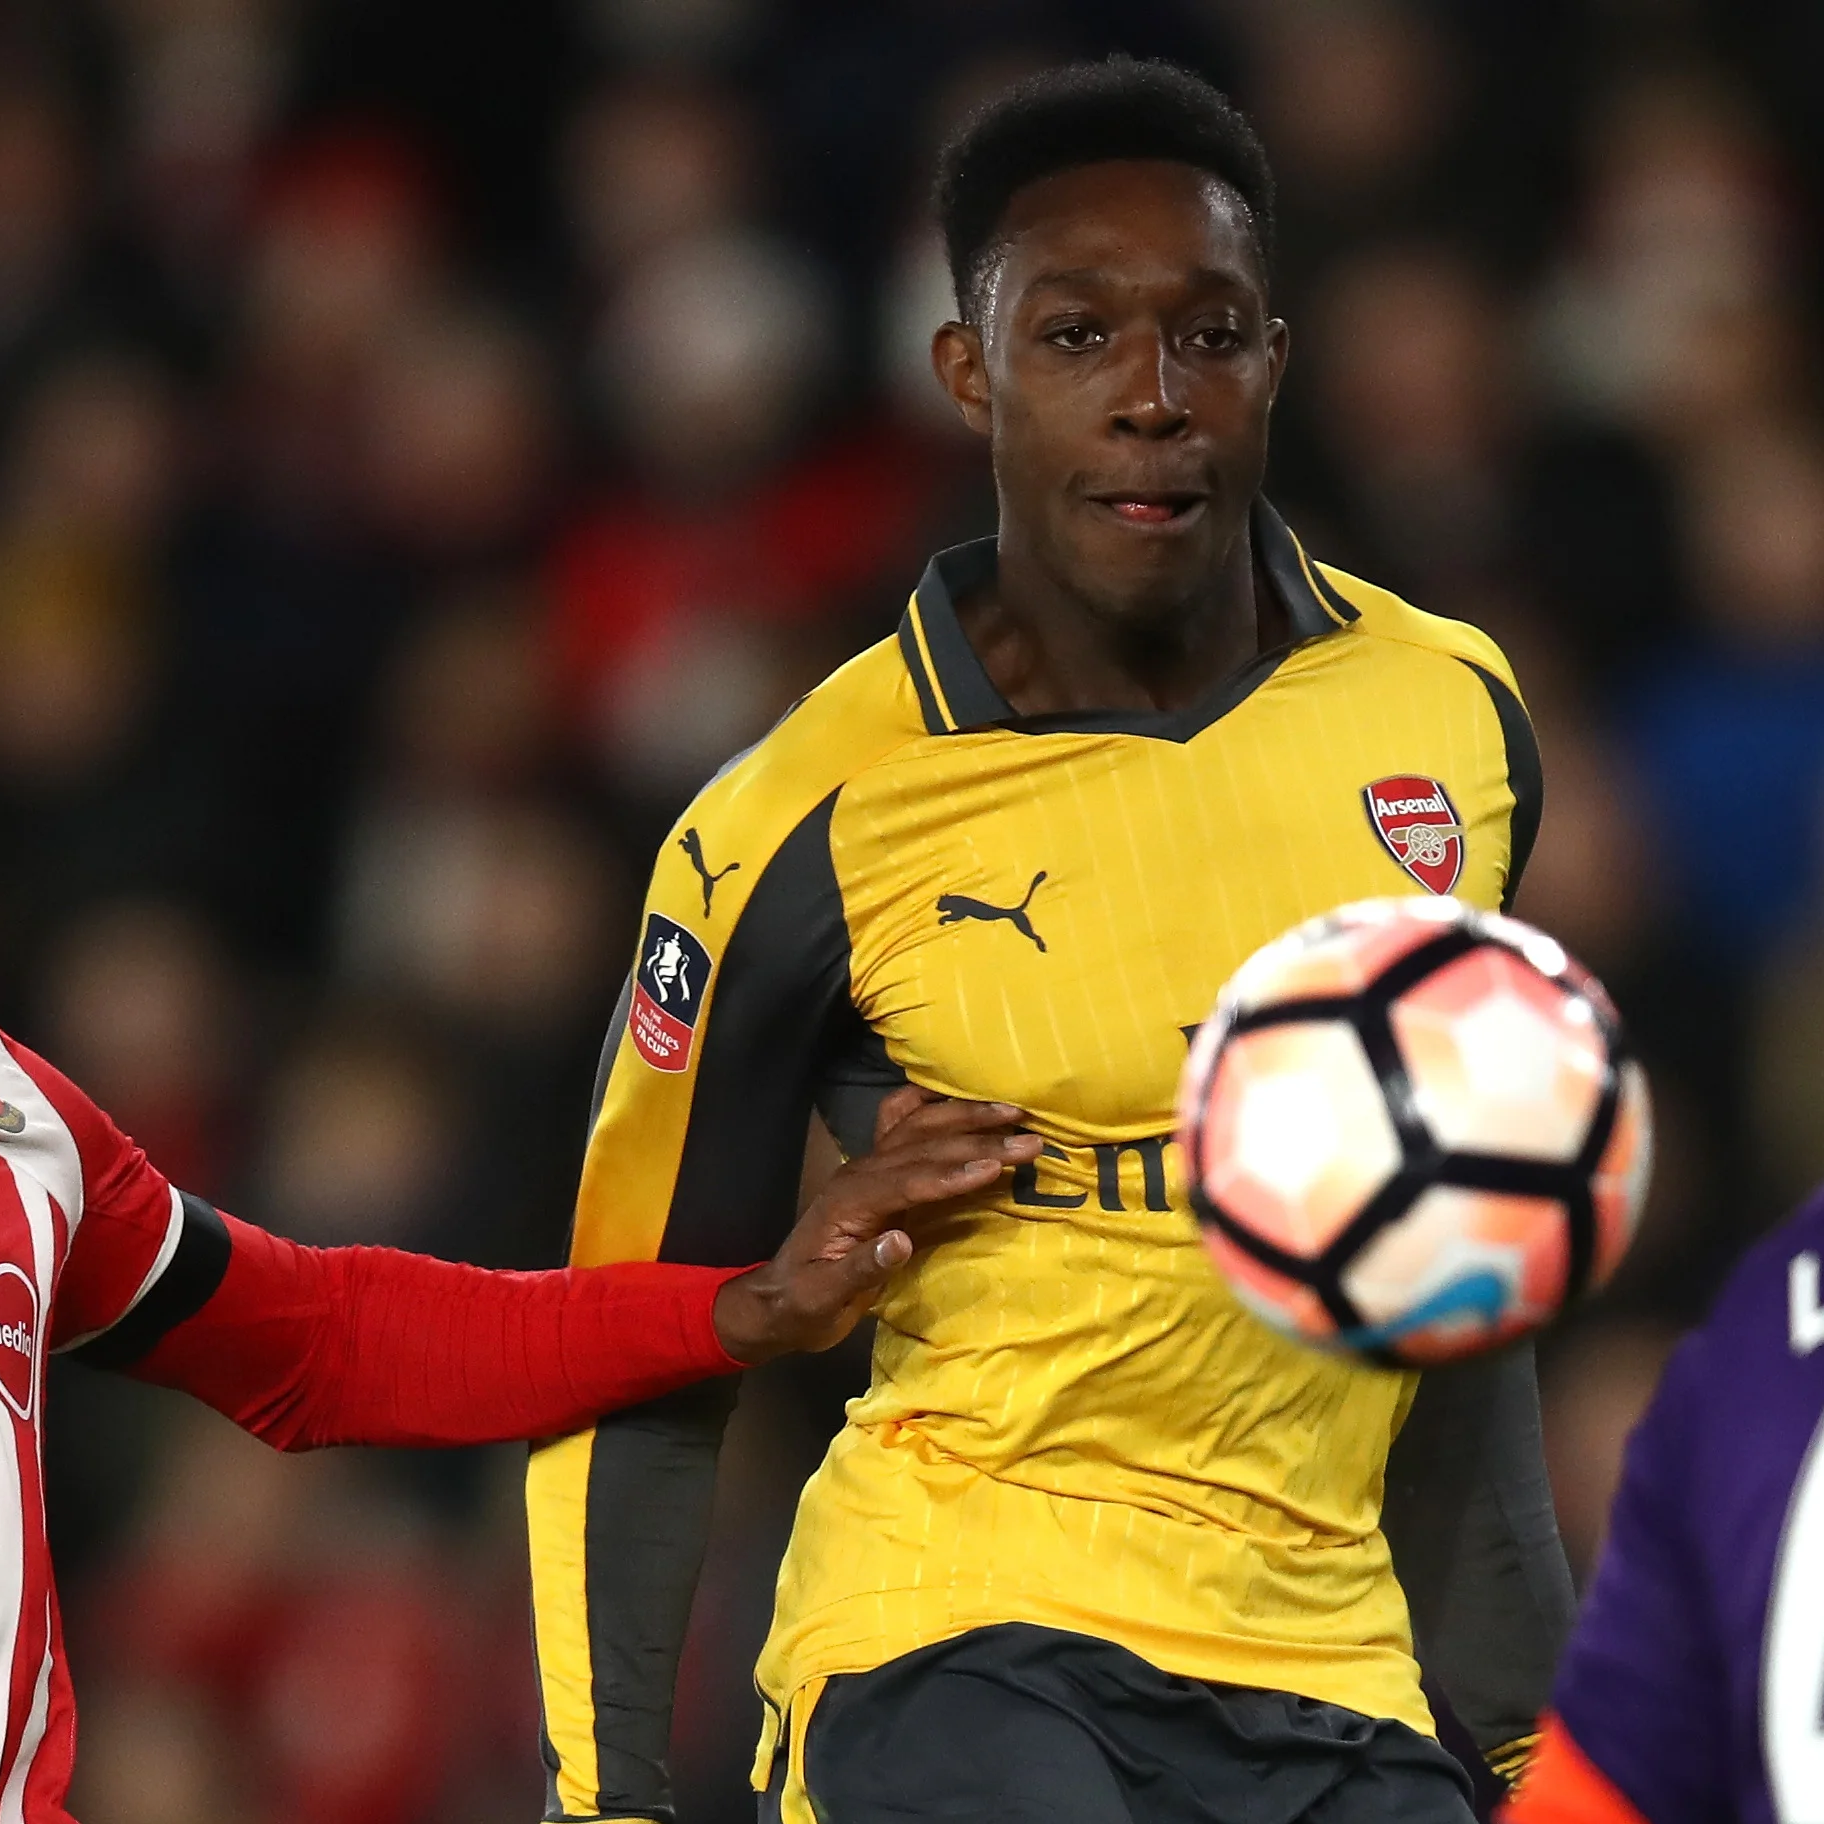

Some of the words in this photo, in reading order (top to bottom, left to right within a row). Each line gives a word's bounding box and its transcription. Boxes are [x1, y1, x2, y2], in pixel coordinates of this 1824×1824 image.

[1376, 793, 1445, 817] Arsenal
[635, 1002, 680, 1051] Emirates
[649, 1008, 663, 1026] THE
